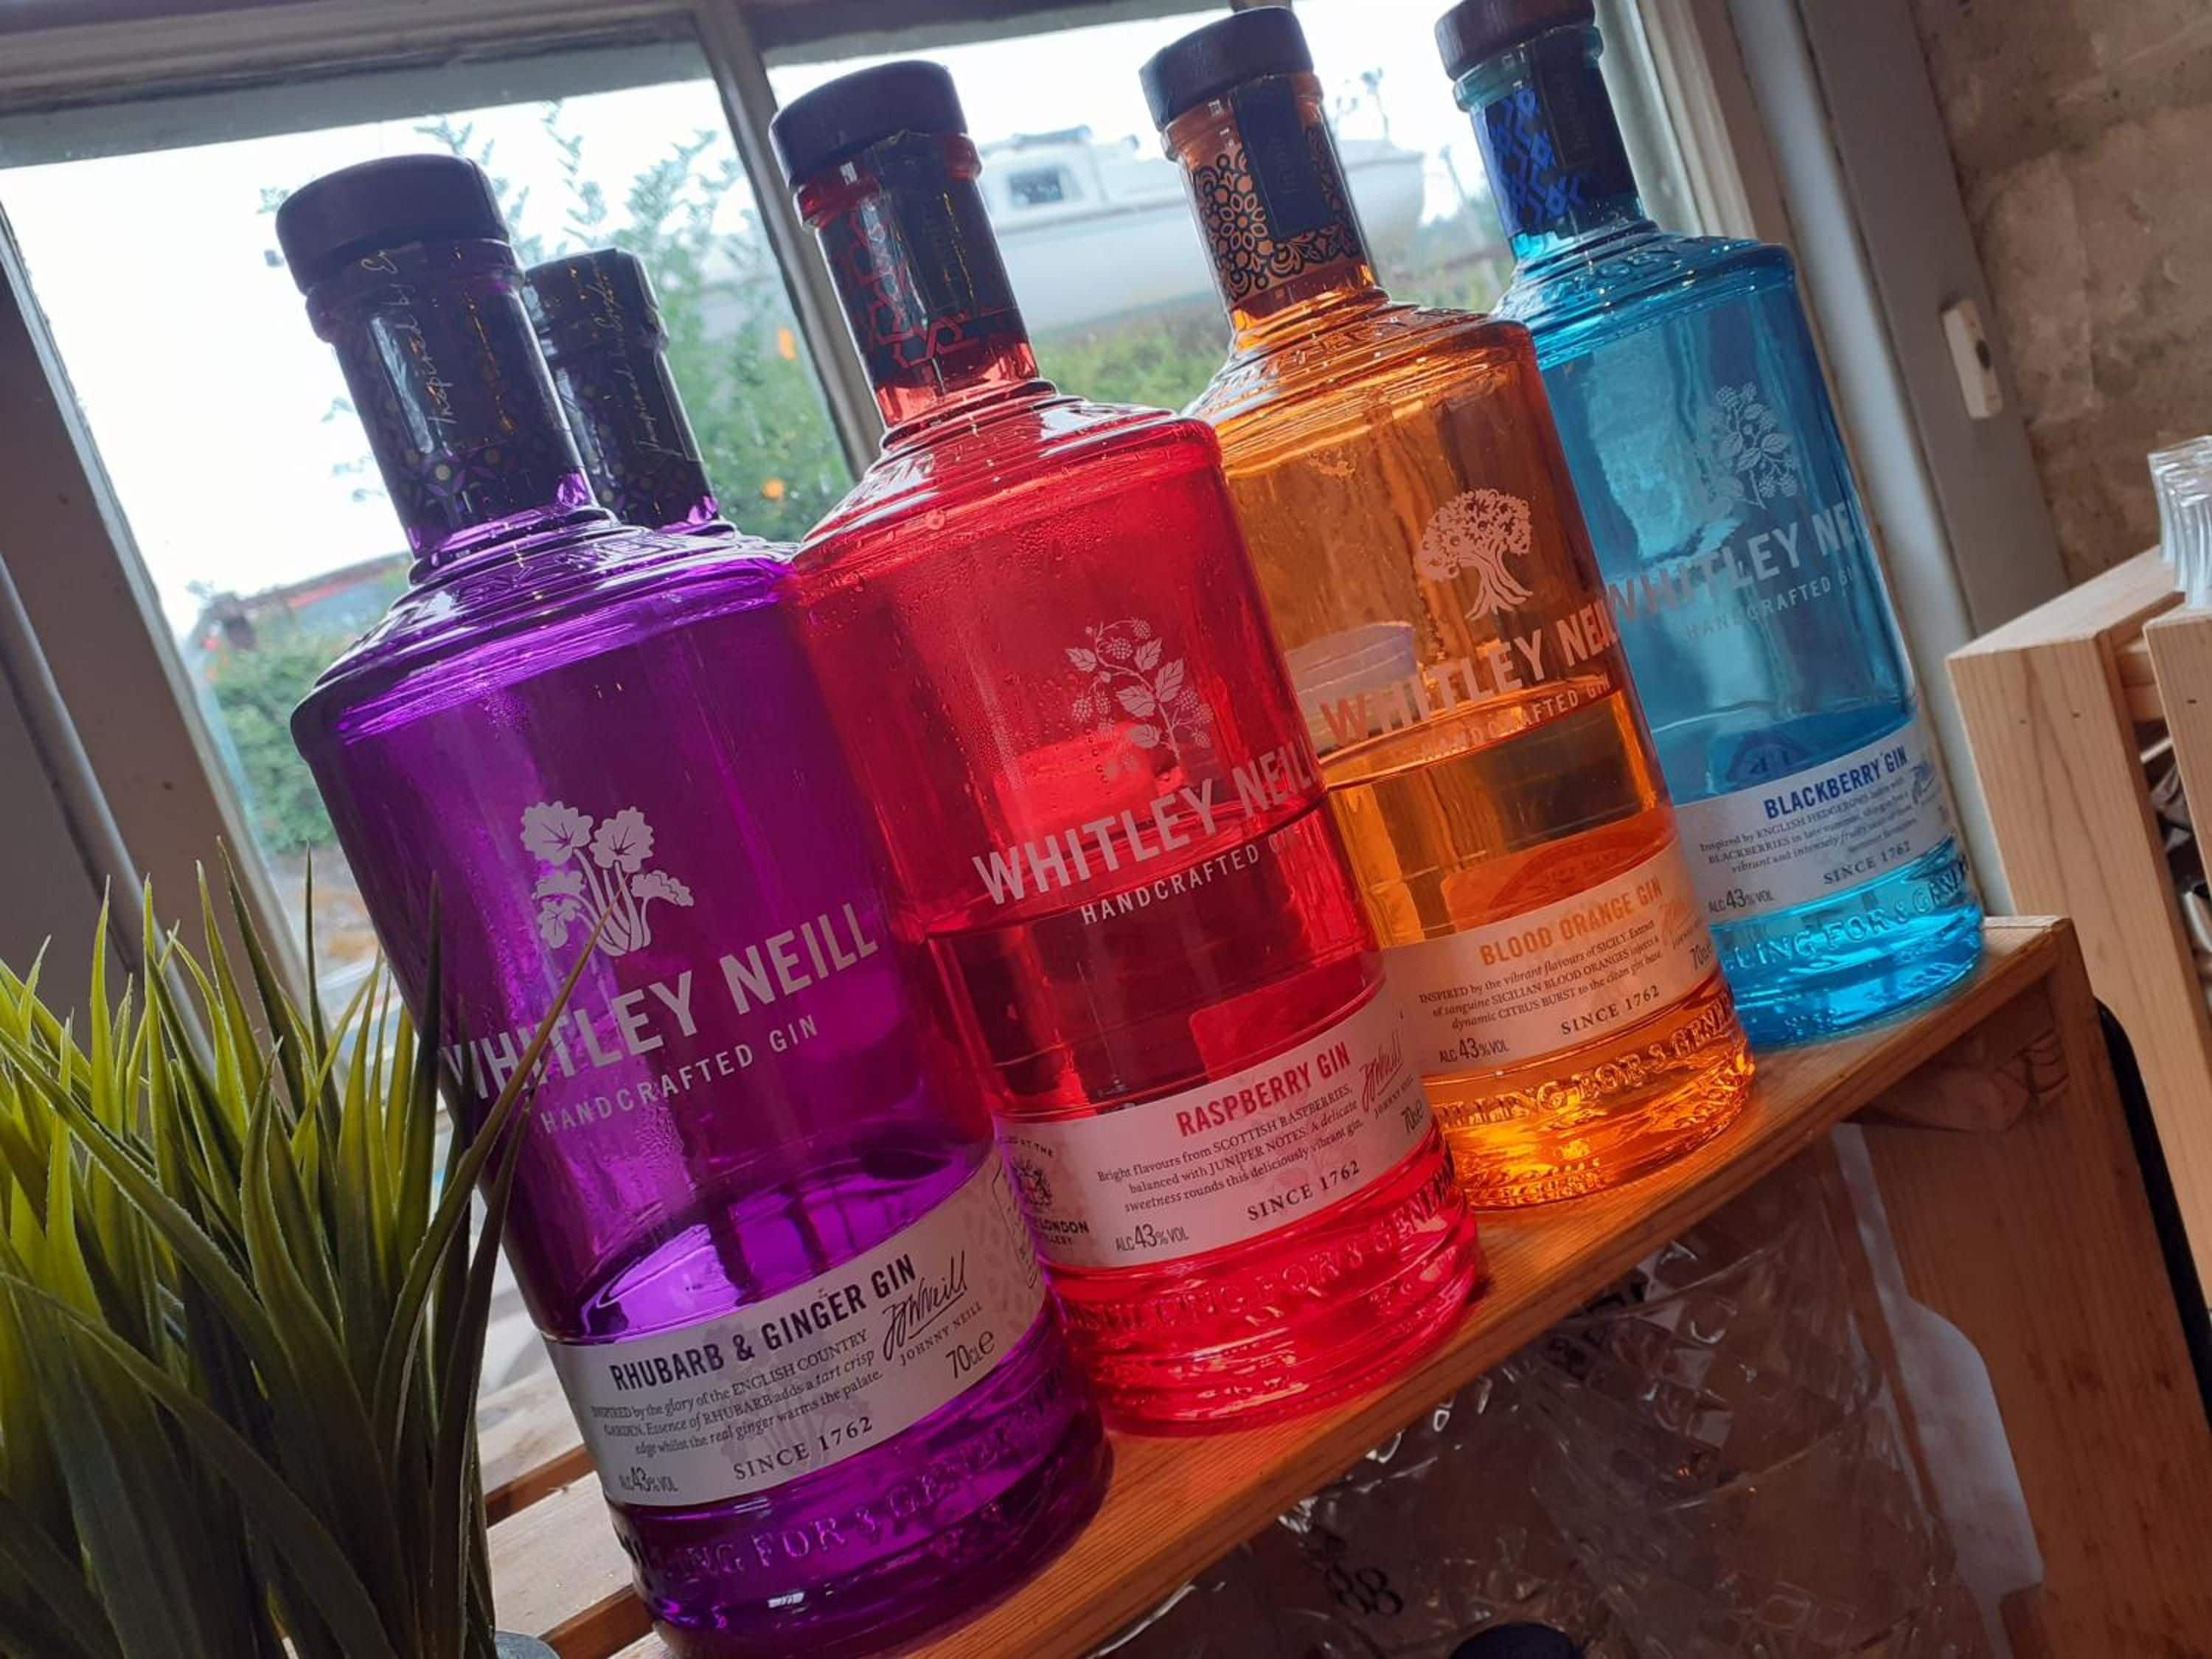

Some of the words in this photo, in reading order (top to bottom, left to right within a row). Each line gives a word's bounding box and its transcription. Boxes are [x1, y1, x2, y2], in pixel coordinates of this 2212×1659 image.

[1321, 629, 1545, 746] WHITLEY
[1763, 759, 1880, 819] BLACKBERRY
[1884, 745, 1908, 773] GIN
[972, 777, 1220, 906] WHITLEY
[1742, 833, 1754, 844] by
[1823, 855, 1877, 885] SINCE
[1079, 844, 1259, 927] HANDCRAFTED
[1479, 926, 1554, 966] BLOOD
[1558, 891, 1634, 941] ORANGE
[1635, 876, 1663, 907] GIN
[719, 903, 879, 1015] NEILL
[1418, 985, 1469, 1004] INSPIRED
[1469, 984, 1484, 995] by
[1484, 979, 1502, 991] the
[1503, 966, 1543, 985] vibrant
[1544, 952, 1585, 976] flavours
[1444, 998, 1491, 1016] sanguine
[1491, 982, 1542, 1005] SICILIAN
[1544, 969, 1582, 990] BLOOD
[1583, 947, 1629, 975] ORANGES
[1451, 1012, 1497, 1032] dynamic
[1498, 1001, 1540, 1019] CITRUS
[1542, 987, 1576, 1008] BURST
[1577, 985, 1589, 995] to
[1590, 978, 1605, 991] the
[1560, 1003, 1621, 1036] SINCE
[1625, 984, 1660, 1012] 1762
[540, 1043, 756, 1134] HANDCRAFTED
[768, 1013, 819, 1054] GIN
[1175, 1061, 1312, 1138] RASPBERRY
[1316, 1041, 1351, 1080] GIN
[1096, 1166, 1133, 1183] Bright
[1133, 1155, 1181, 1177] flavours
[1181, 1147, 1212, 1164] from
[1212, 1119, 1278, 1155] SCOTTISH
[1124, 1191, 1183, 1213] sweetness
[1183, 1178, 1225, 1200] rounds
[1225, 1171, 1250, 1189] this
[1250, 1145, 1310, 1179] deliciously
[1310, 1127, 1346, 1152] vibrant
[1128, 1172, 1180, 1194] balanced
[1180, 1166, 1208, 1183] with
[1206, 1143, 1265, 1176] JUNIPER
[1319, 1099, 1358, 1128] delicate
[1246, 1183, 1314, 1222] SINCE
[1318, 1159, 1361, 1192] 1762
[609, 1343, 725, 1391] RHUBARB
[732, 1334, 756, 1362] &
[760, 1284, 867, 1351] GINGER
[870, 1253, 917, 1299] GIN
[900, 1326, 950, 1366] JOHNNY
[952, 1301, 984, 1331] NEILL
[644, 1403, 664, 1417] the
[665, 1397, 695, 1417] glory
[695, 1392, 709, 1407] of
[709, 1388, 731, 1403] the
[731, 1363, 796, 1396] ENGLISH
[796, 1328, 869, 1371] COUNTRY
[646, 1417, 686, 1436] Essence
[689, 1414, 703, 1432] of
[702, 1391, 773, 1425] RHUBARB
[774, 1382, 805, 1403] adds
[805, 1381, 815, 1391] a
[815, 1364, 841, 1387] tart
[844, 1349, 875, 1373] crisp
[689, 1434, 709, 1449] the
[709, 1424, 734, 1442] real
[734, 1414, 774, 1441] ginger
[776, 1399, 820, 1424] warms
[819, 1389, 841, 1406] the
[841, 1369, 884, 1399] palate.
[733, 1442, 810, 1481] SINCE
[818, 1416, 873, 1452] 1762
